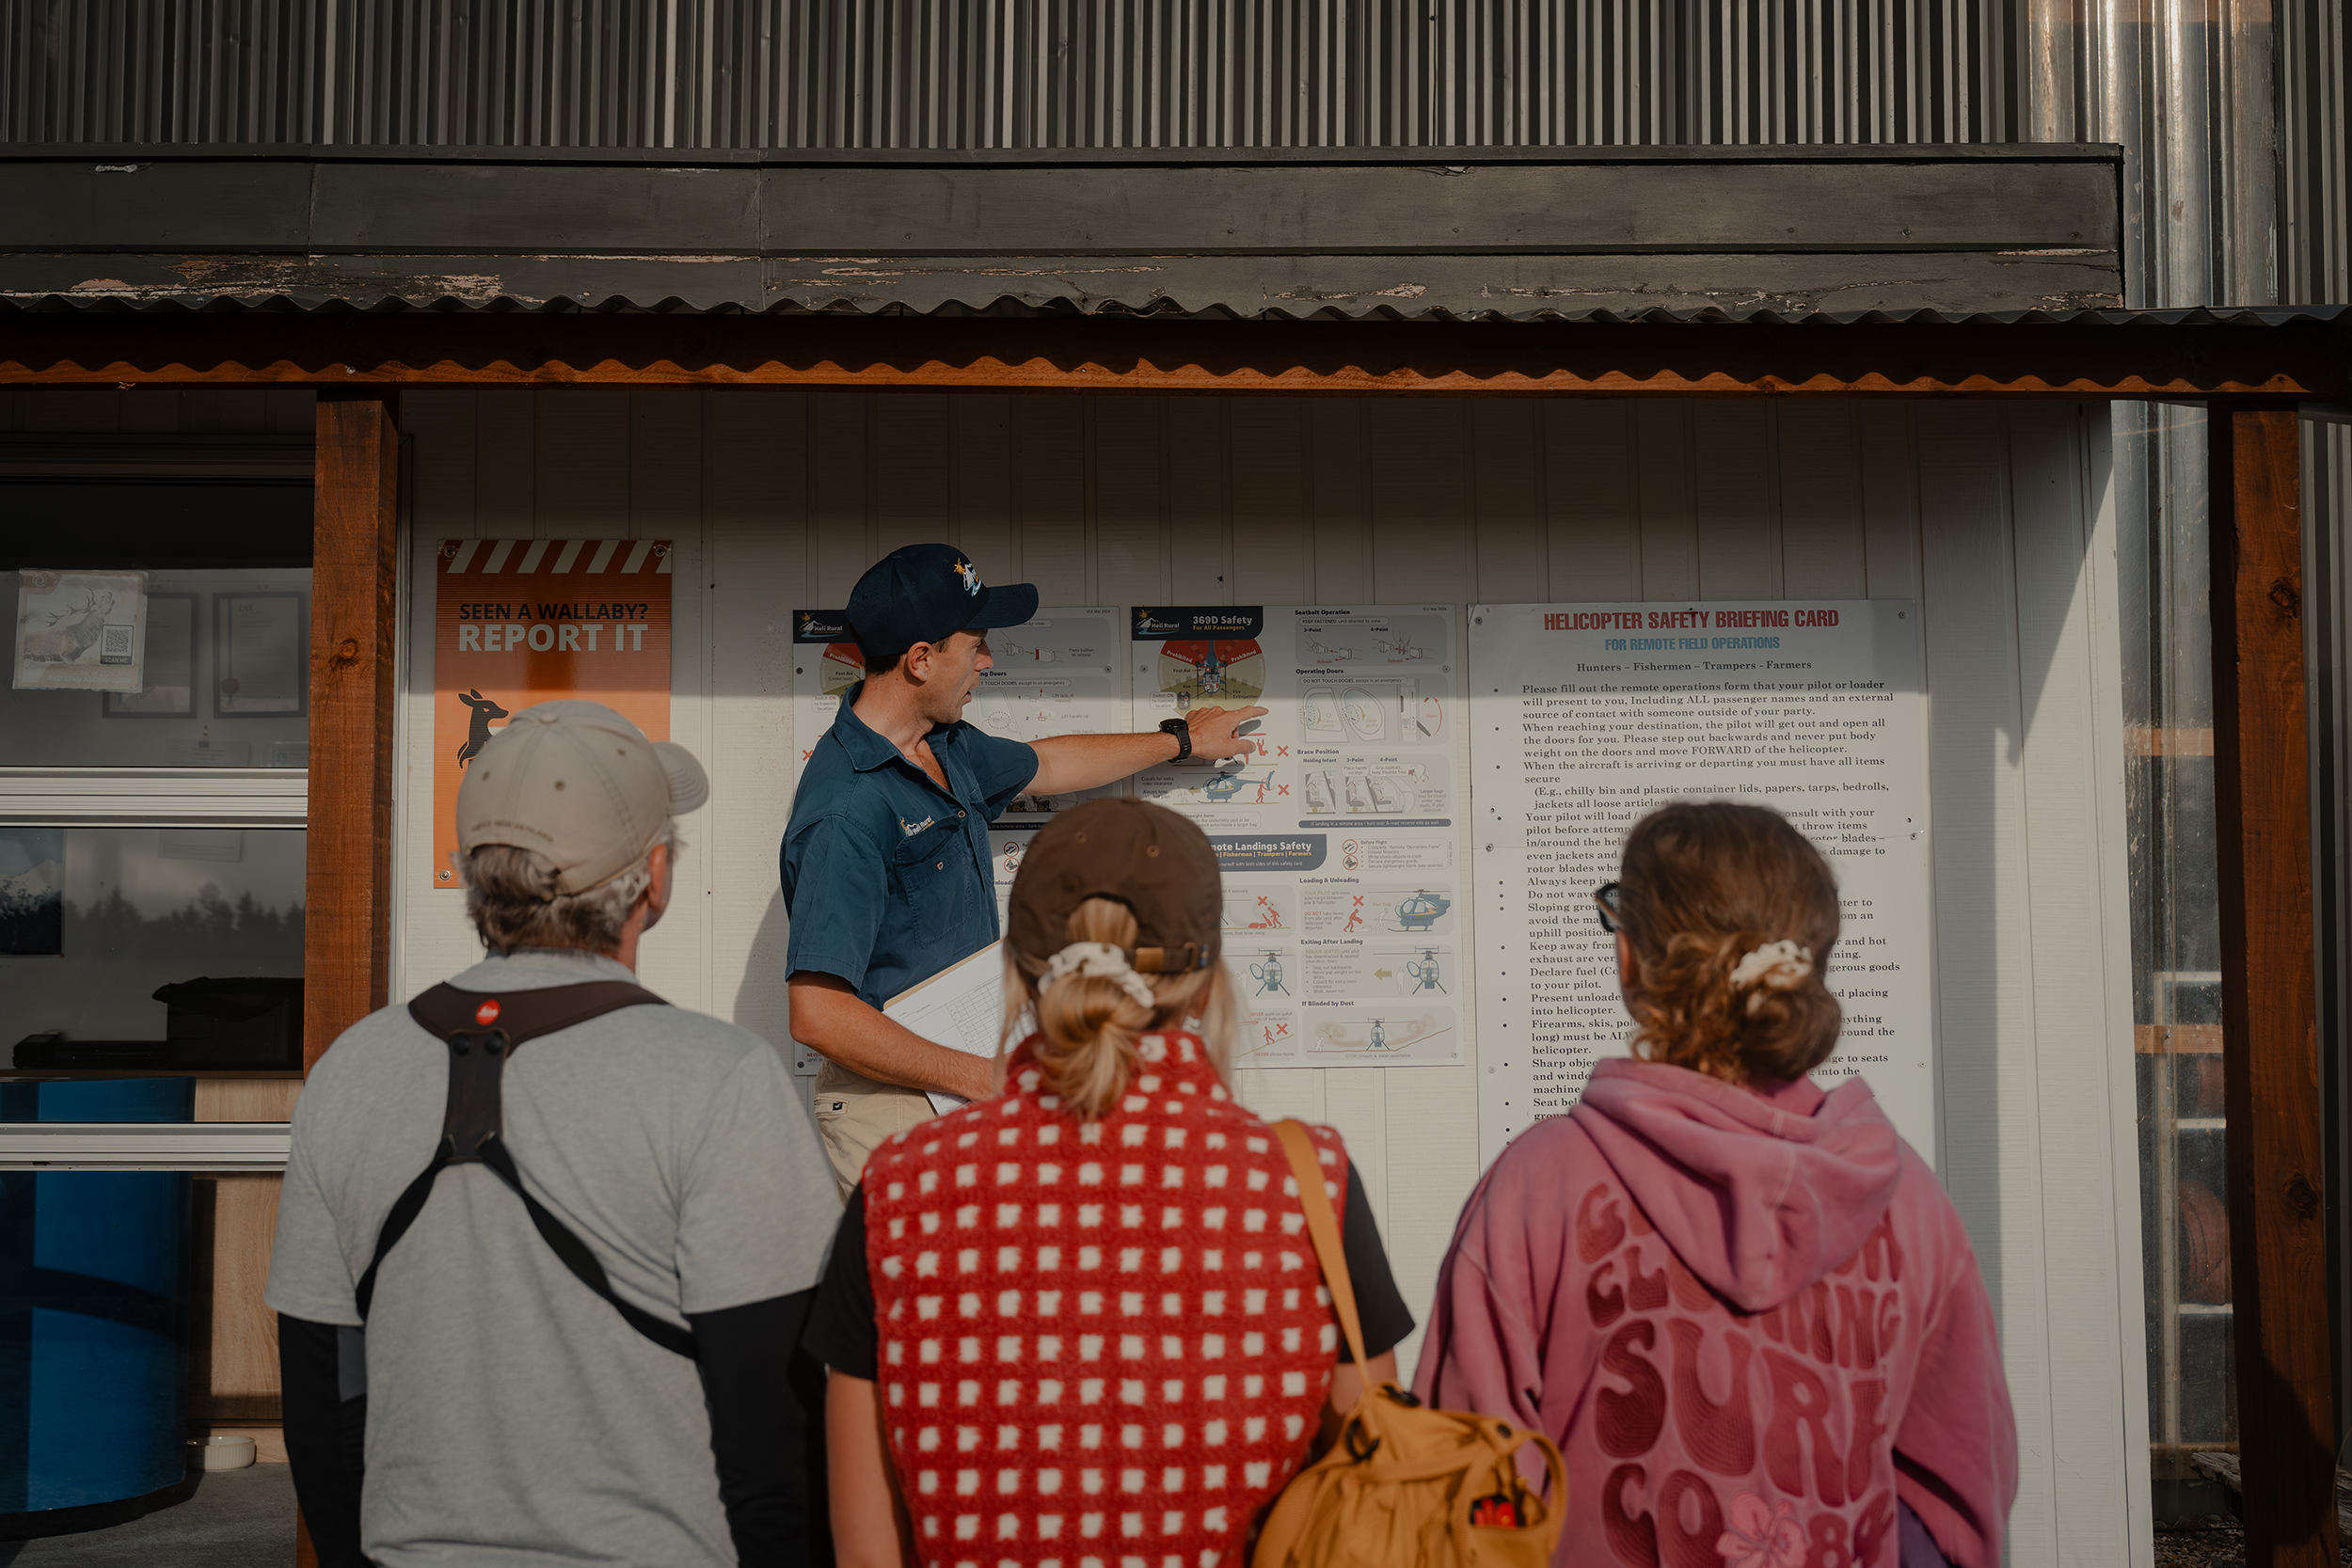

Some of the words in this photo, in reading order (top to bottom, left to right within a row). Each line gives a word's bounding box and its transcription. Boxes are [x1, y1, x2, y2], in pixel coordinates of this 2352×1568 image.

[459, 604, 510, 620] SEEN
[517, 604, 532, 619] A
[537, 603, 648, 619] WALLABY?
[1193, 616, 1218, 625] 369D
[1221, 615, 1252, 626] Safety
[1544, 611, 1643, 630] HELICOPTER
[1647, 610, 1709, 629] SAFETY
[1715, 610, 1789, 628] BRIEFING
[1794, 610, 1839, 627] CARD
[459, 624, 603, 652] REPORT
[615, 624, 648, 651] IT
[1605, 639, 1627, 651] FOR
[1629, 638, 1676, 651] REMOTE
[1678, 638, 1708, 650] FIELD
[1711, 636, 1780, 650] OPERATIONS
[830, 653, 855, 665] Prohibited
[1167, 650, 1193, 663] Prohibited
[1231, 649, 1257, 662] Prohibited
[1577, 663, 1622, 672] Hunters
[1633, 662, 1692, 671] Fishermen
[1702, 661, 1756, 672] Trampers
[1766, 660, 1812, 670] Farmers
[1522, 685, 1558, 694] Please
[1561, 684, 1576, 692] fill
[1579, 685, 1597, 693] out
[1600, 683, 1618, 692] the
[1662, 682, 1722, 693] operations
[1724, 682, 1750, 690] form
[1753, 681, 1776, 690] that
[1778, 683, 1804, 691] your
[1807, 680, 1833, 691] pilot
[1850, 680, 1884, 689] loader
[1522, 697, 1543, 706] will
[1547, 698, 1588, 707] present
[1604, 699, 1628, 707] you,
[1631, 695, 1684, 705] Including
[1686, 695, 1710, 704] ALL
[1713, 696, 1768, 705] passenger
[1808, 693, 1829, 703] and
[1849, 692, 1893, 702] external
[1562, 709, 1574, 719] of
[1575, 710, 1616, 719] contact
[1619, 708, 1645, 718] with
[1697, 707, 1738, 717] outside
[1740, 706, 1753, 717] of
[1754, 709, 1780, 718] your
[1783, 707, 1816, 717] party.
[1522, 722, 1554, 732] When
[1557, 722, 1606, 732] reaching
[1609, 724, 1634, 733] your
[1637, 721, 1703, 730] destination,
[1706, 721, 1724, 730] the
[1726, 720, 1752, 731] pilot
[1755, 720, 1774, 728] will
[1778, 721, 1795, 730] get
[1819, 719, 1839, 728] and
[1842, 721, 1868, 729] open
[1871, 718, 1885, 727] all
[1211, 843, 1232, 851] mote
[1235, 842, 1278, 852] Landings
[1280, 841, 1311, 852] Safety
[1544, 982, 1570, 991] your
[1573, 979, 1601, 990] pilot.
[1532, 1006, 1553, 1016] into
[1556, 1006, 1615, 1016] helicopter.
[1532, 1045, 1592, 1055] helicopter.
